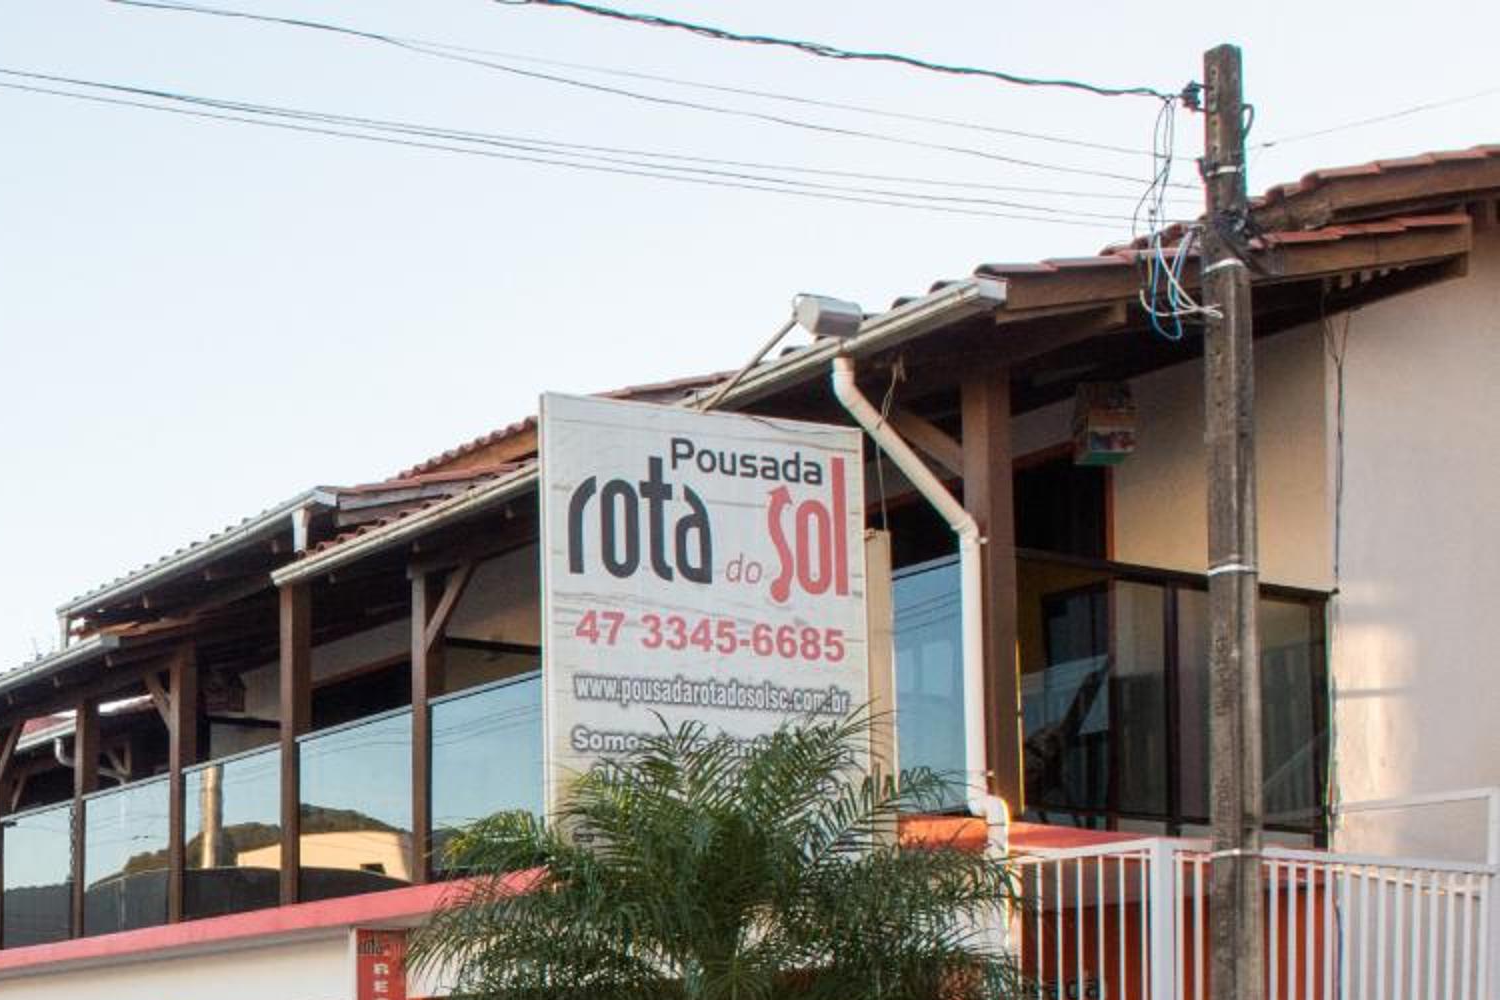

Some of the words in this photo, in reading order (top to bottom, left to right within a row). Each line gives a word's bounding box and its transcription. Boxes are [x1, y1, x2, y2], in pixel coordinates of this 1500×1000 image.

[671, 438, 823, 485] Pousada
[568, 456, 713, 584] rota
[725, 553, 762, 584] do
[575, 610, 625, 646] 47
[641, 614, 845, 663] 3345-6685
[572, 726, 646, 751] Somo
